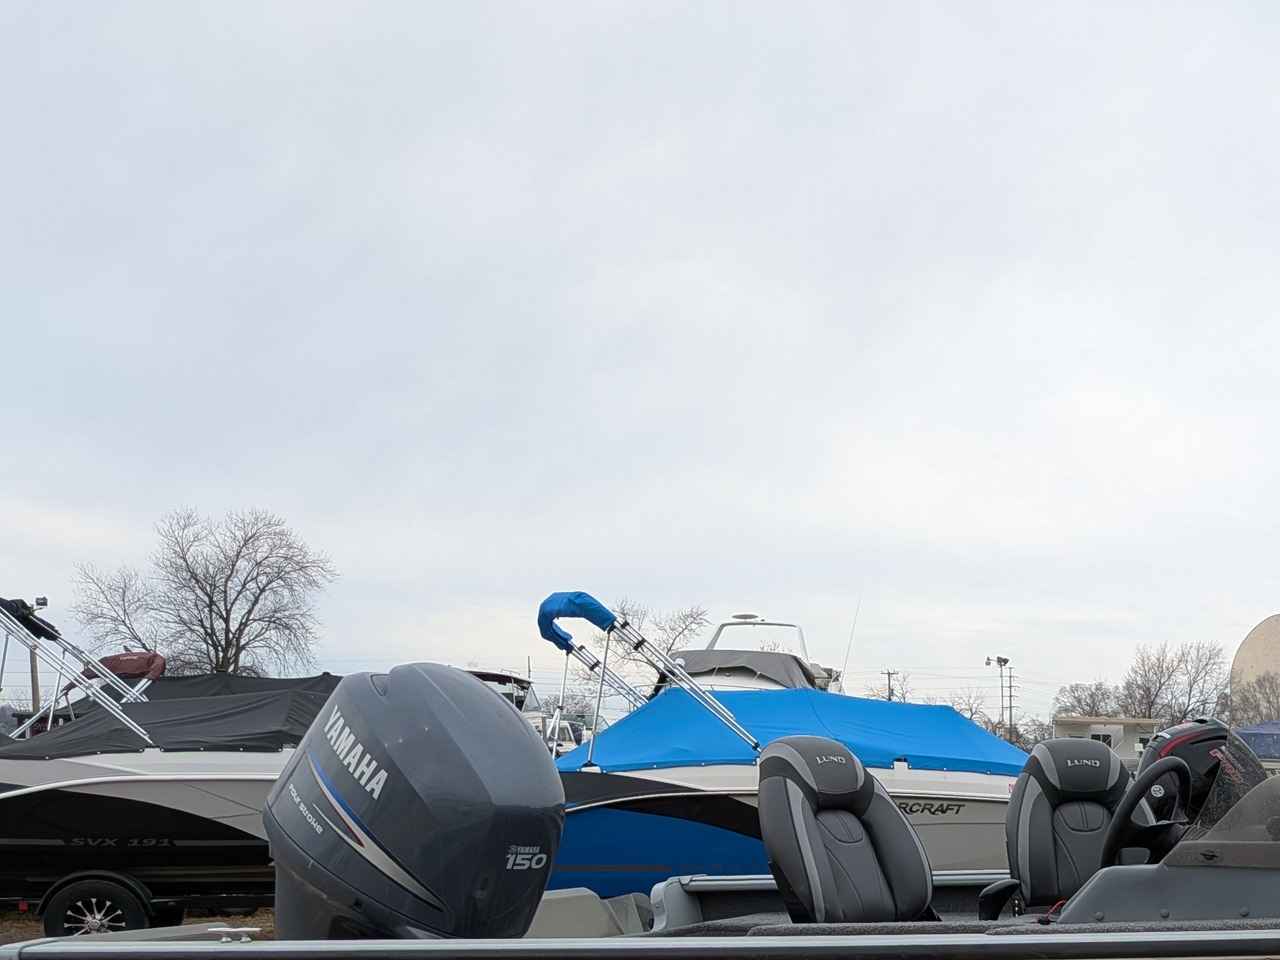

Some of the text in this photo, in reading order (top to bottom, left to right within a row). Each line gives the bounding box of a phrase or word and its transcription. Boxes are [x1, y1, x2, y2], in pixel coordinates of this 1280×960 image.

[324, 704, 388, 800] YAMAHA
[816, 755, 846, 764] LUND
[1066, 759, 1101, 767] LUND
[898, 802, 966, 815] RCRAFT
[71, 838, 169, 847] SVX 191
[505, 853, 548, 870] 150
